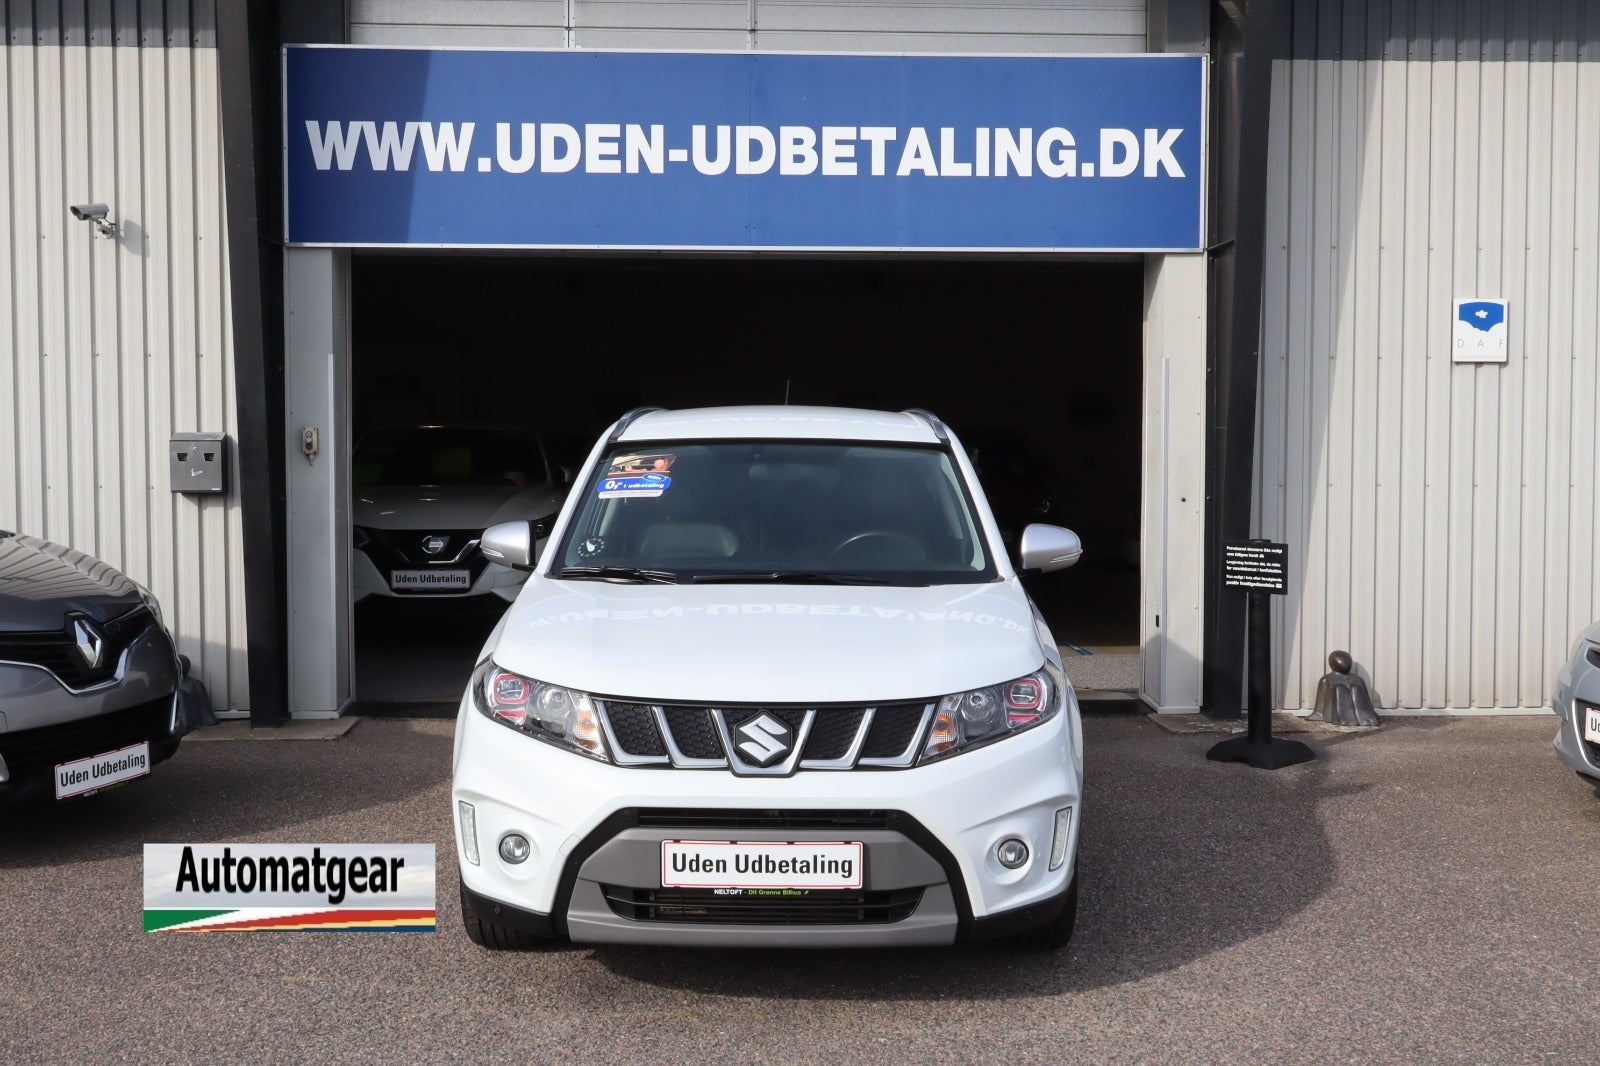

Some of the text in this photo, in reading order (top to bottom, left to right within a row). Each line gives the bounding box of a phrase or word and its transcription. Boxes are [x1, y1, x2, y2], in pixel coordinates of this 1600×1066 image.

[305, 120, 1185, 178] WWW.UDEN-UDBETALING.DK
[395, 574, 466, 584] Uden Udbetaling
[60, 769, 89, 787] Uden
[92, 753, 145, 778] Udbetaling
[672, 852, 853, 878] Uden Udbetaling
